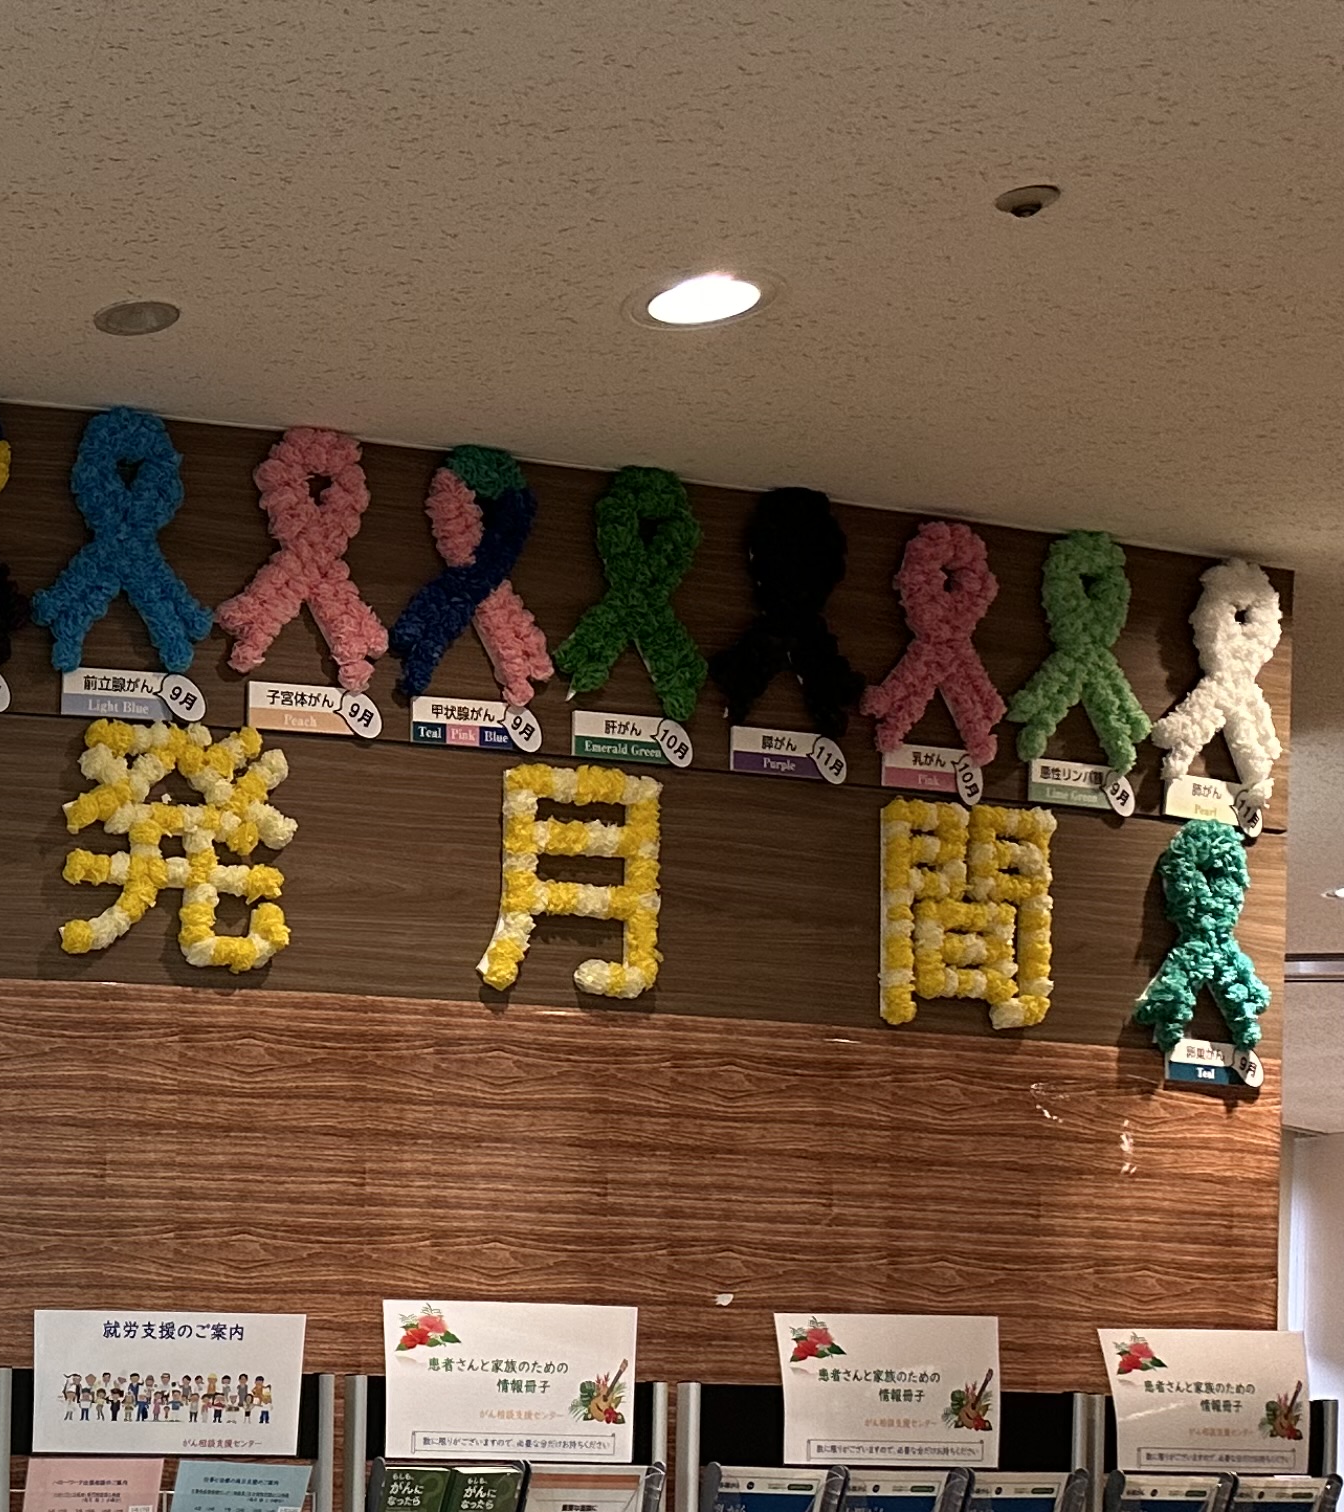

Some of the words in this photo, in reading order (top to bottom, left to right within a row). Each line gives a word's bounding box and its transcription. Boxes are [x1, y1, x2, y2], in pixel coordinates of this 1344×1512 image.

[83, 675, 155, 694] 前立腺がん
[87, 698, 119, 716] Light
[122, 702, 149, 715] Blue
[172, 685, 198, 711] 9月
[266, 688, 335, 708] 子宮体がん
[283, 713, 318, 728] Peach
[348, 702, 375, 728] 9月
[431, 704, 496, 722] 甲状腺がん
[418, 725, 442, 739] Teal
[450, 727, 476, 742] Pink
[484, 730, 509, 744] Blue
[511, 715, 535, 742] 9月
[604, 719, 642, 736] 肝がん
[584, 740, 628, 756] Emerald
[630, 744, 662, 758] Green
[659, 728, 689, 760] 10月
[763, 757, 796, 773] Purple
[815, 745, 844, 777] 11月
[912, 751, 946, 768] 乳がん
[917, 773, 940, 787] Pink
[958, 762, 980, 799] 10月
[1110, 781, 1131, 807] 9月
[1196, 1066, 1216, 1080] Teal
[102, 1319, 246, 1342] 就労支援のご案内
[427, 1356, 570, 1375] 患者さんと家族のための
[818, 1367, 942, 1385] 患者さんと家族のための
[496, 1378, 552, 1395] 情報冊子
[877, 1386, 926, 1402] 情報冊子
[1143, 1379, 1256, 1396] 患者さんと家族のための
[1199, 1398, 1243, 1414] 情報冊子
[389, 1482, 425, 1496] がんに
[462, 1485, 498, 1499] がんに
[386, 1496, 421, 1507] なったら
[460, 1499, 495, 1510] なったら
